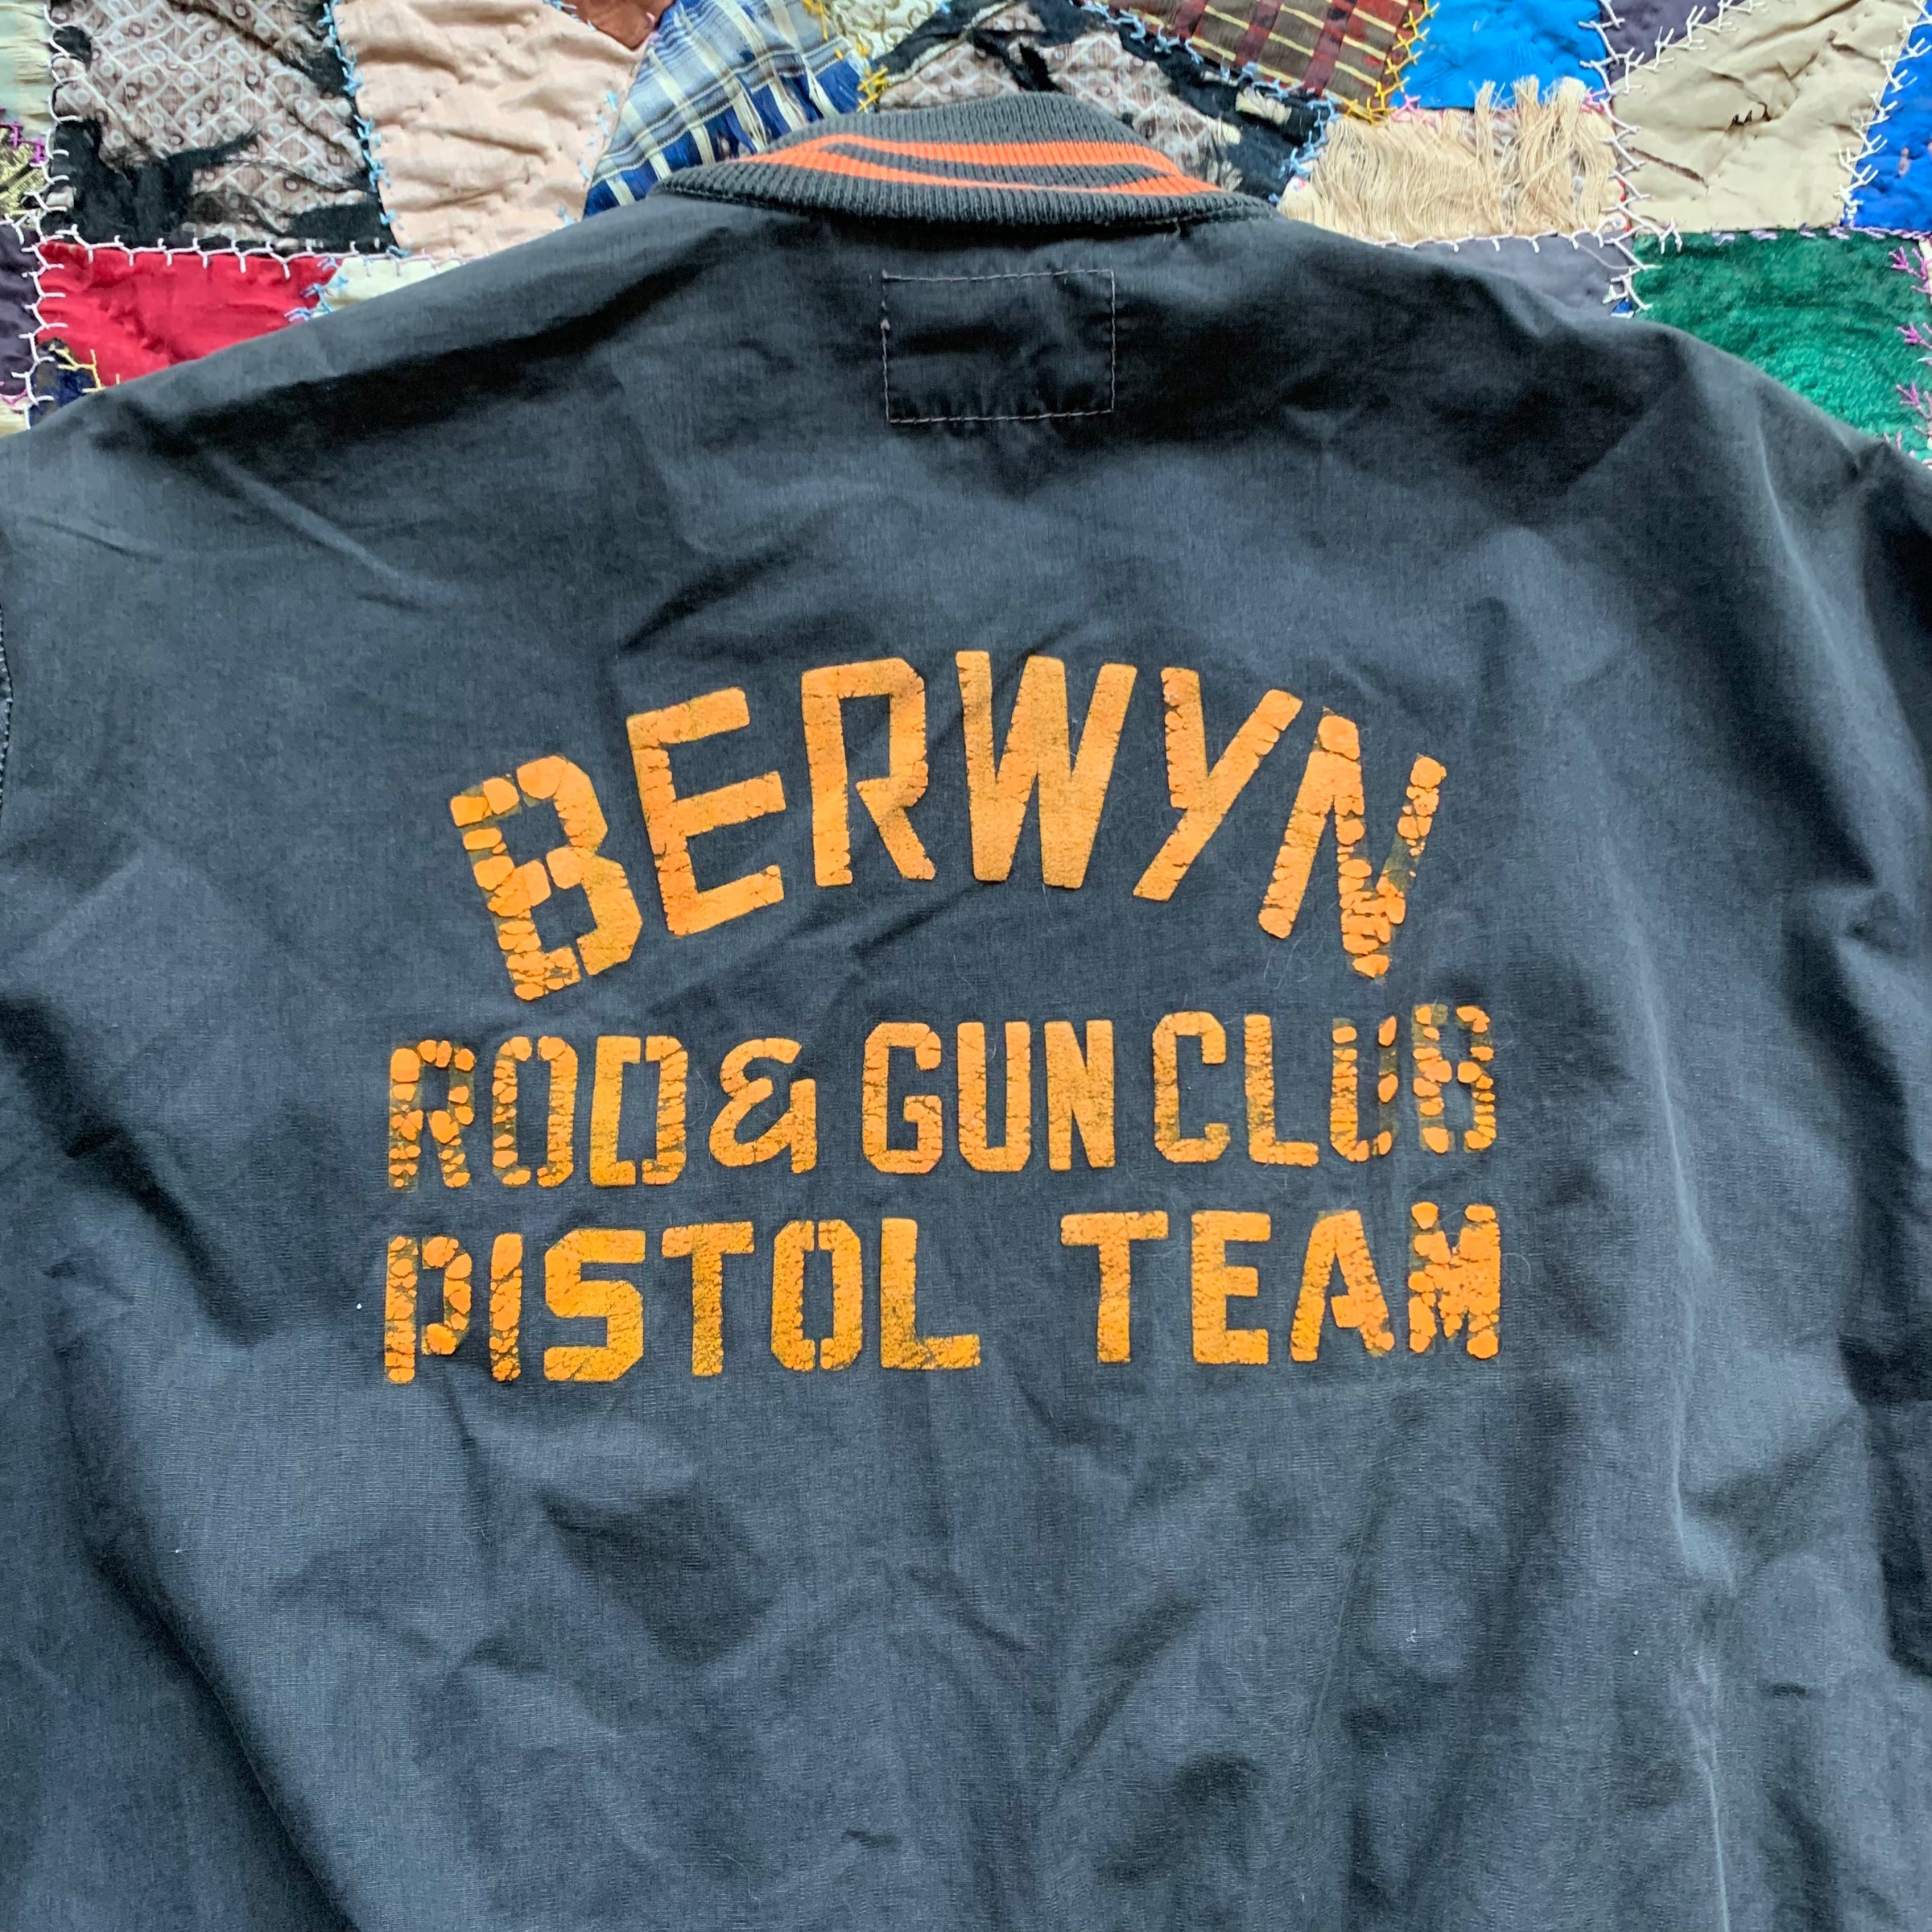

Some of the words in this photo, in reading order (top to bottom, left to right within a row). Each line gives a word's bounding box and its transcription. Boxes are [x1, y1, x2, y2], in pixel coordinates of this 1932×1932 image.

[452, 651, 1444, 1000] BERWYN
[388, 1035, 687, 1188] ROD
[709, 1038, 816, 1173] &
[862, 1021, 1114, 1173] GUN
[1153, 1005, 1496, 1166] CLUB
[384, 1219, 979, 1384] PISTOL
[1062, 1202, 1501, 1364] TEAM
